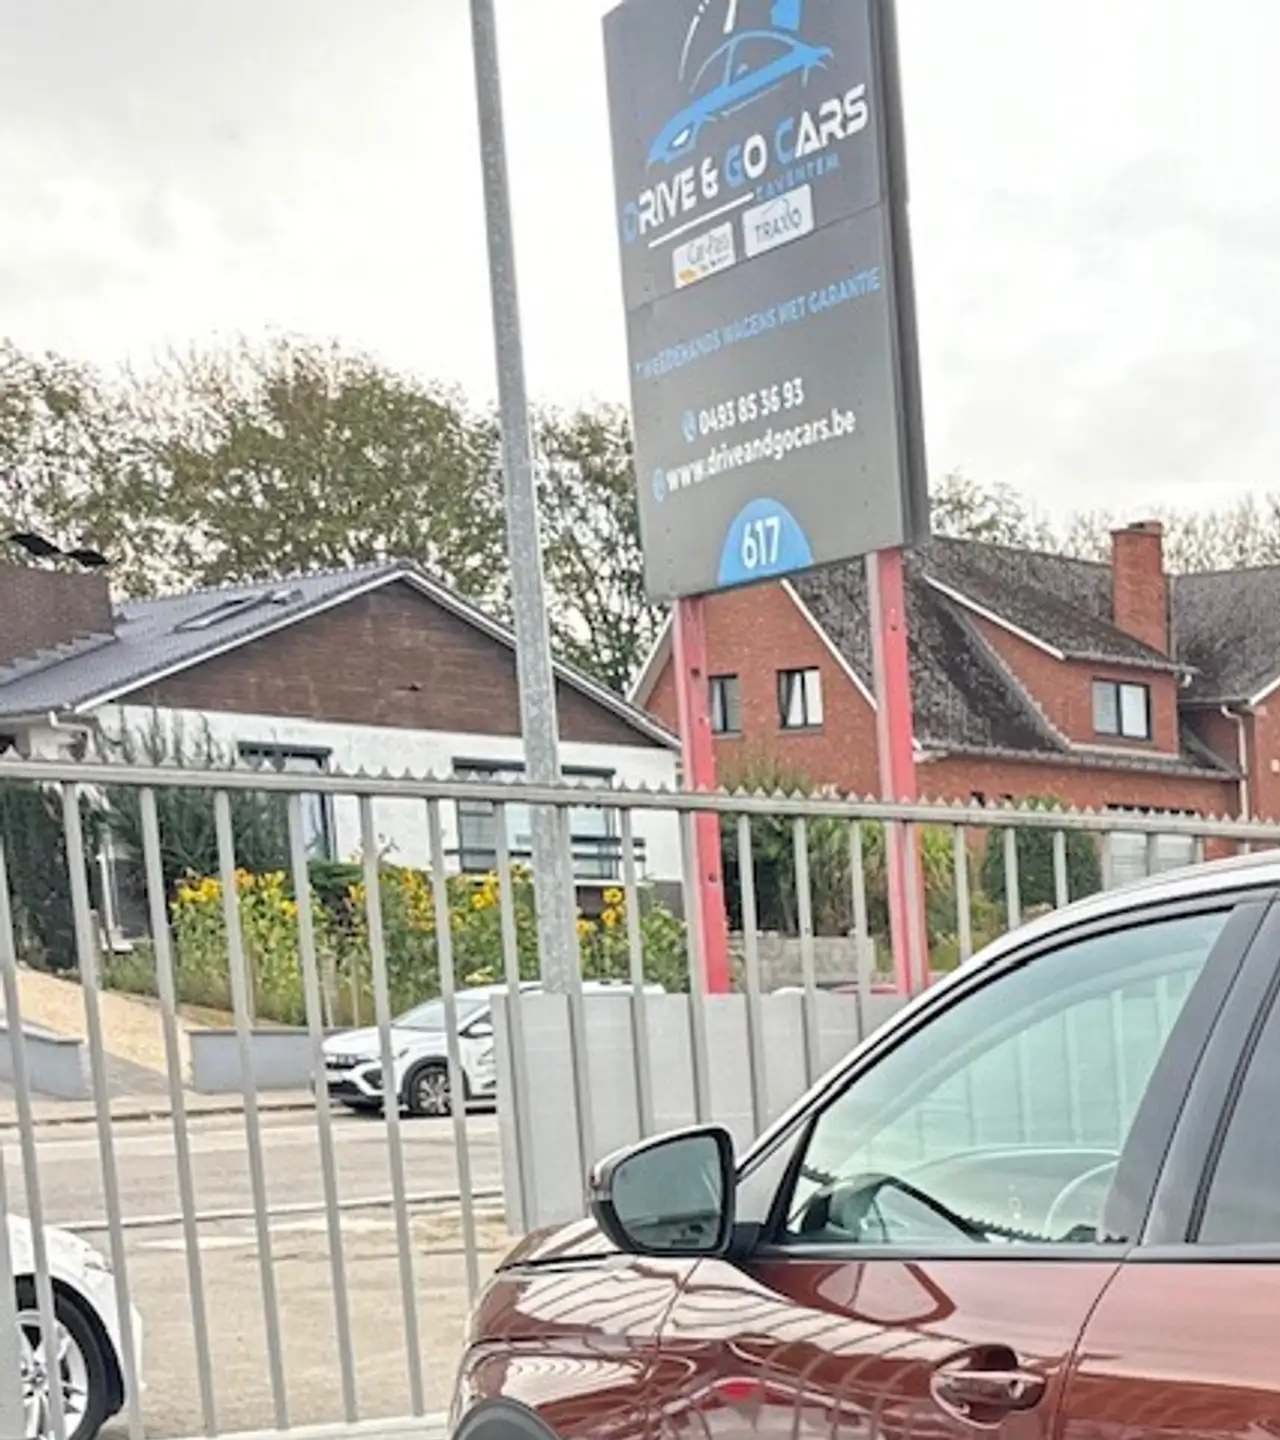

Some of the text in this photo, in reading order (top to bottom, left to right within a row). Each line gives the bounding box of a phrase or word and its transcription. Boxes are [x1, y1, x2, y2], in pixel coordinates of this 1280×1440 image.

[622, 83, 869, 244] DRIVE & GO CARS
[783, 377, 804, 407] 93
[665, 407, 856, 493] www.driveandgocars.be
[740, 515, 781, 570] 617
